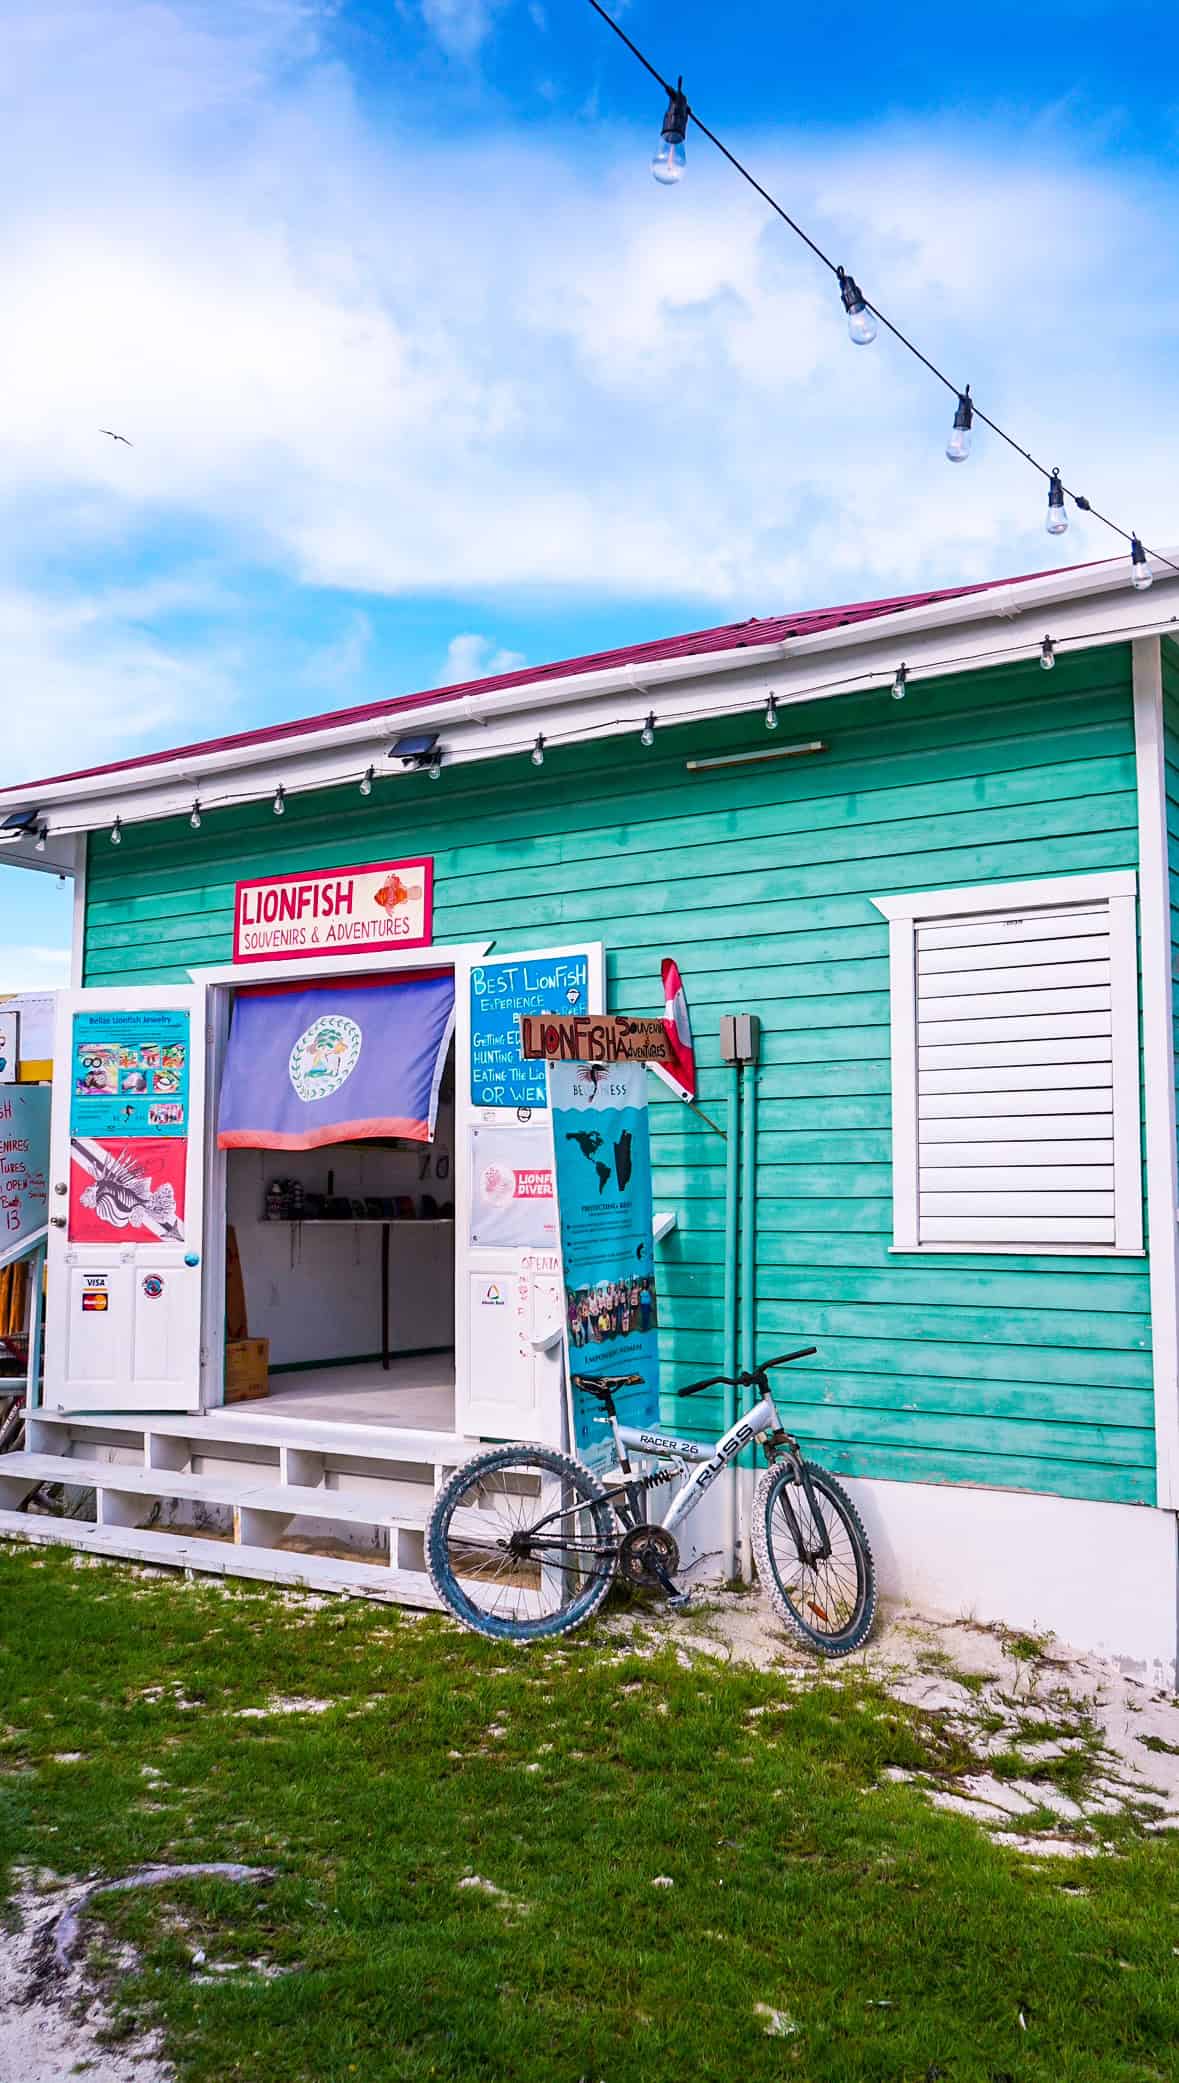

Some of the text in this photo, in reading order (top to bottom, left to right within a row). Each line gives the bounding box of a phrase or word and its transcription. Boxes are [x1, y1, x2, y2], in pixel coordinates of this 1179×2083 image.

[242, 880, 354, 925] LIONFISH
[244, 916, 411, 950] SOUVENIRS & ADVENTURES
[471, 967, 519, 995] BEST
[522, 1016, 616, 1061] LIONFISH
[481, 1087, 505, 1104] OR
[518, 1184, 553, 1195] DIVER
[6, 1209, 21, 1231] 13
[87, 1278, 105, 1287] VISA
[640, 1434, 699, 1455] RACER 26
